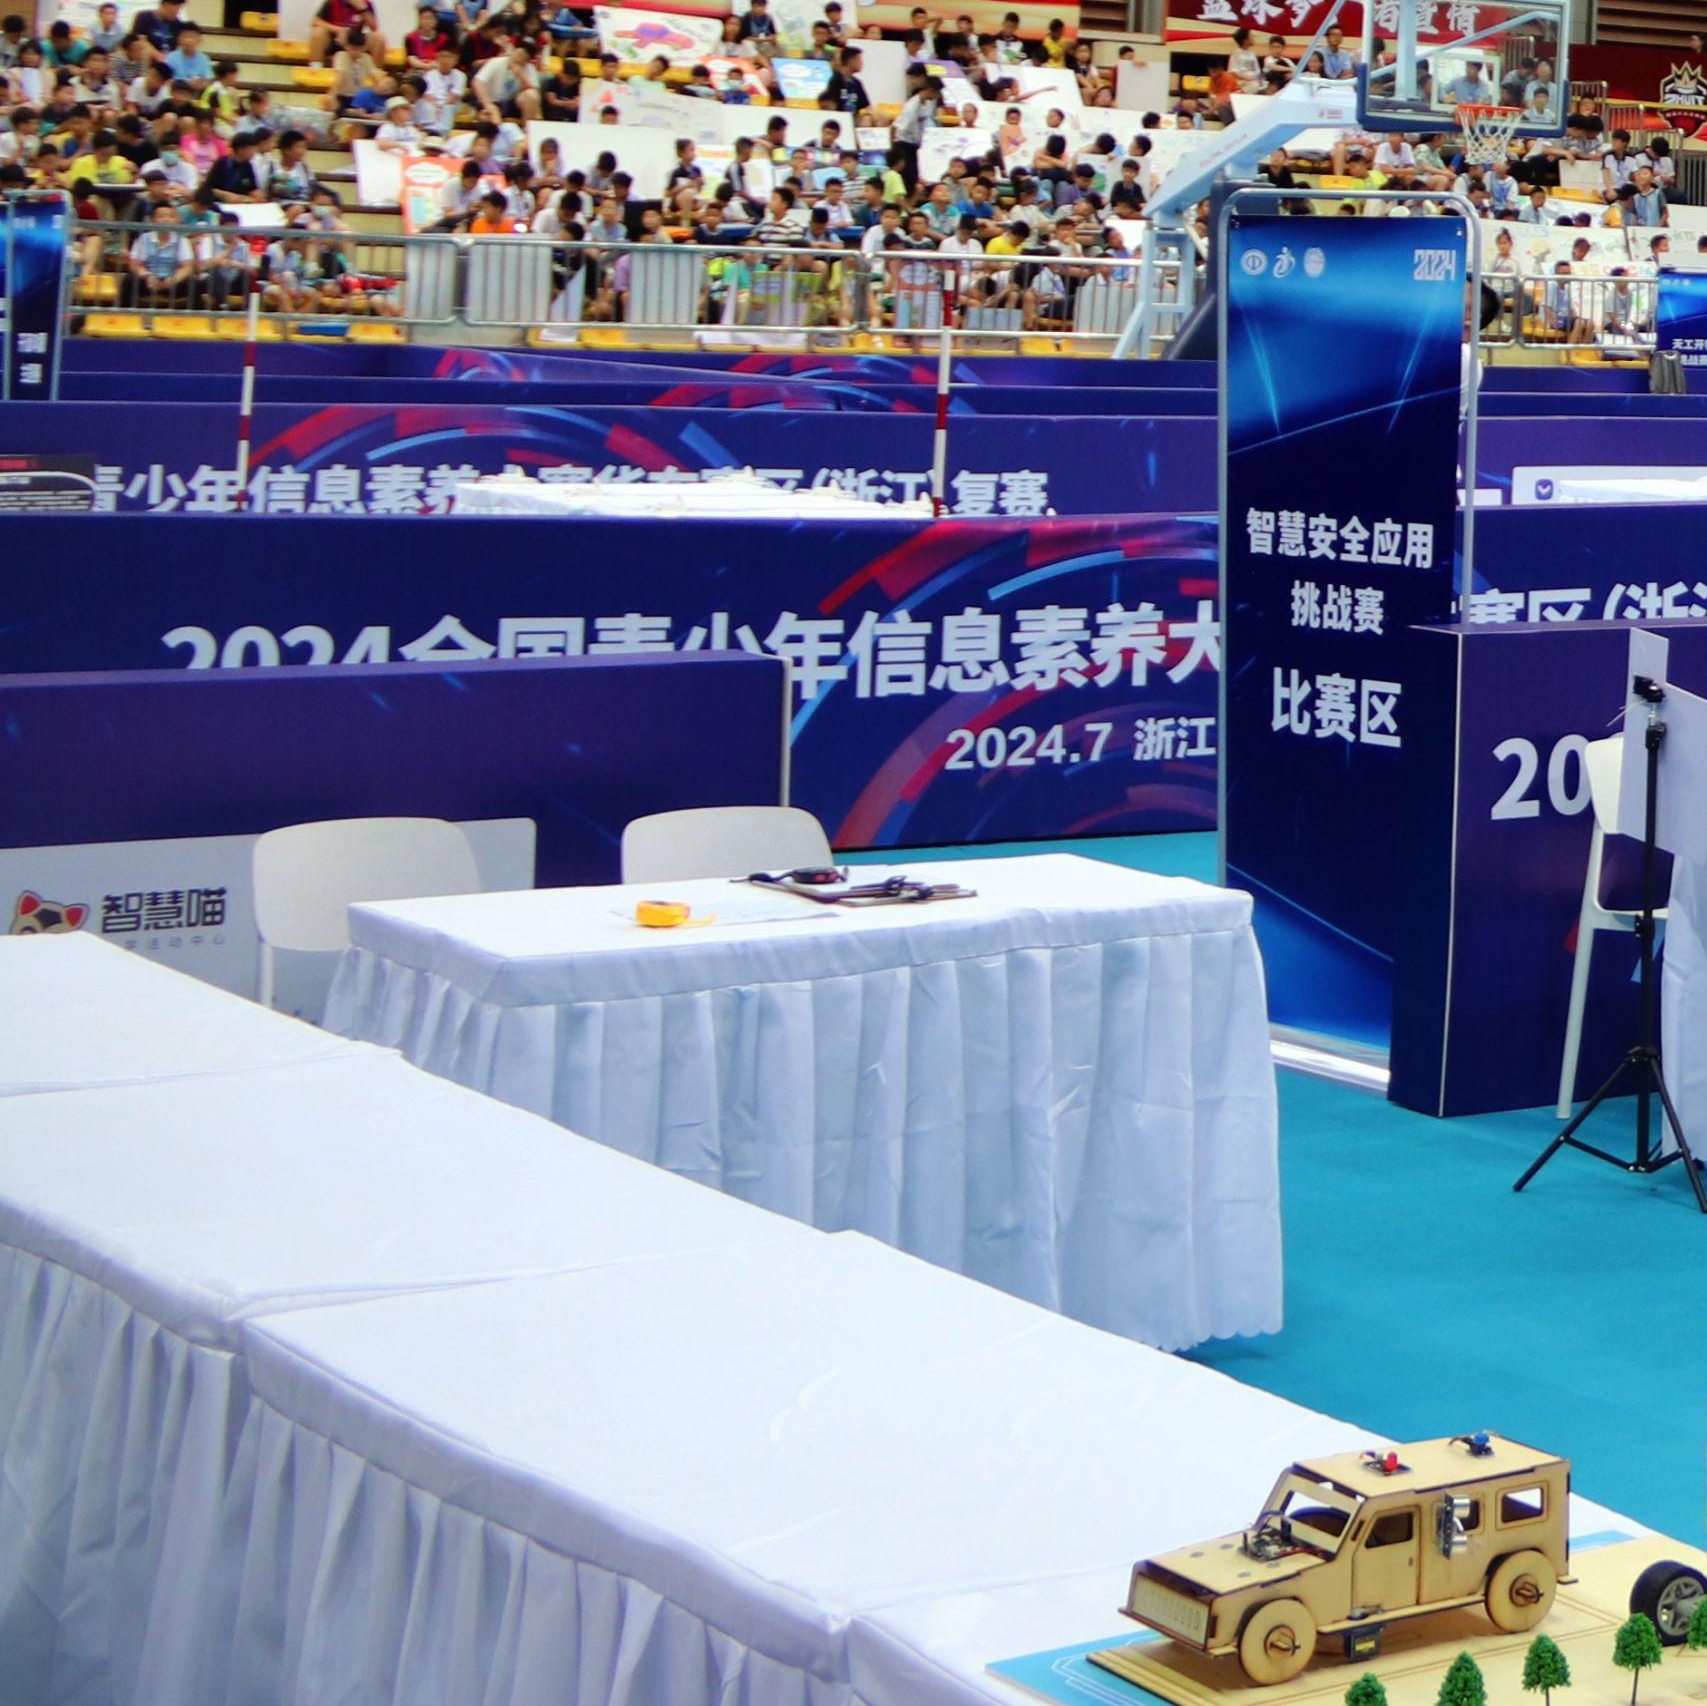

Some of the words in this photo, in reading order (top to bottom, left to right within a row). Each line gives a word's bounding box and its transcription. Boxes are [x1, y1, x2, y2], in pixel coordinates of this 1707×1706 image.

[1245, 507, 1435, 570] 智慧安全应用
[1289, 578, 1385, 637] 挑战赛
[1269, 665, 1403, 749] 比赛区
[942, 722, 1112, 771] 2024.7
[101, 885, 228, 934] 智慧喵
